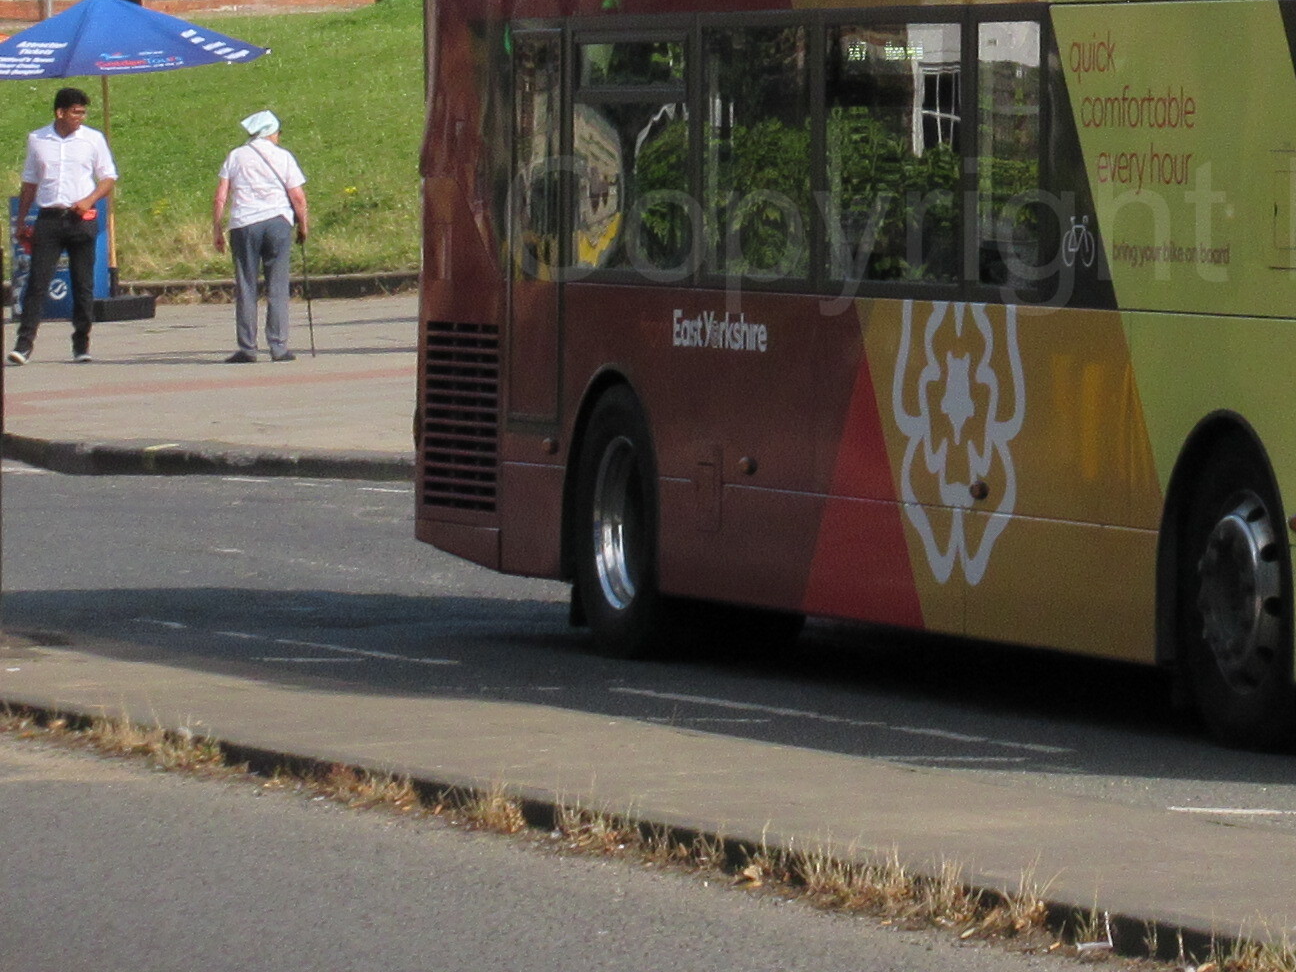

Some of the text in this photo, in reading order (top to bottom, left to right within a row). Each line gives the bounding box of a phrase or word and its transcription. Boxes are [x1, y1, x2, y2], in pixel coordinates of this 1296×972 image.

[1070, 31, 1116, 84] quick
[1081, 85, 1196, 129] comfortable
[1097, 142, 1194, 195] every hour
